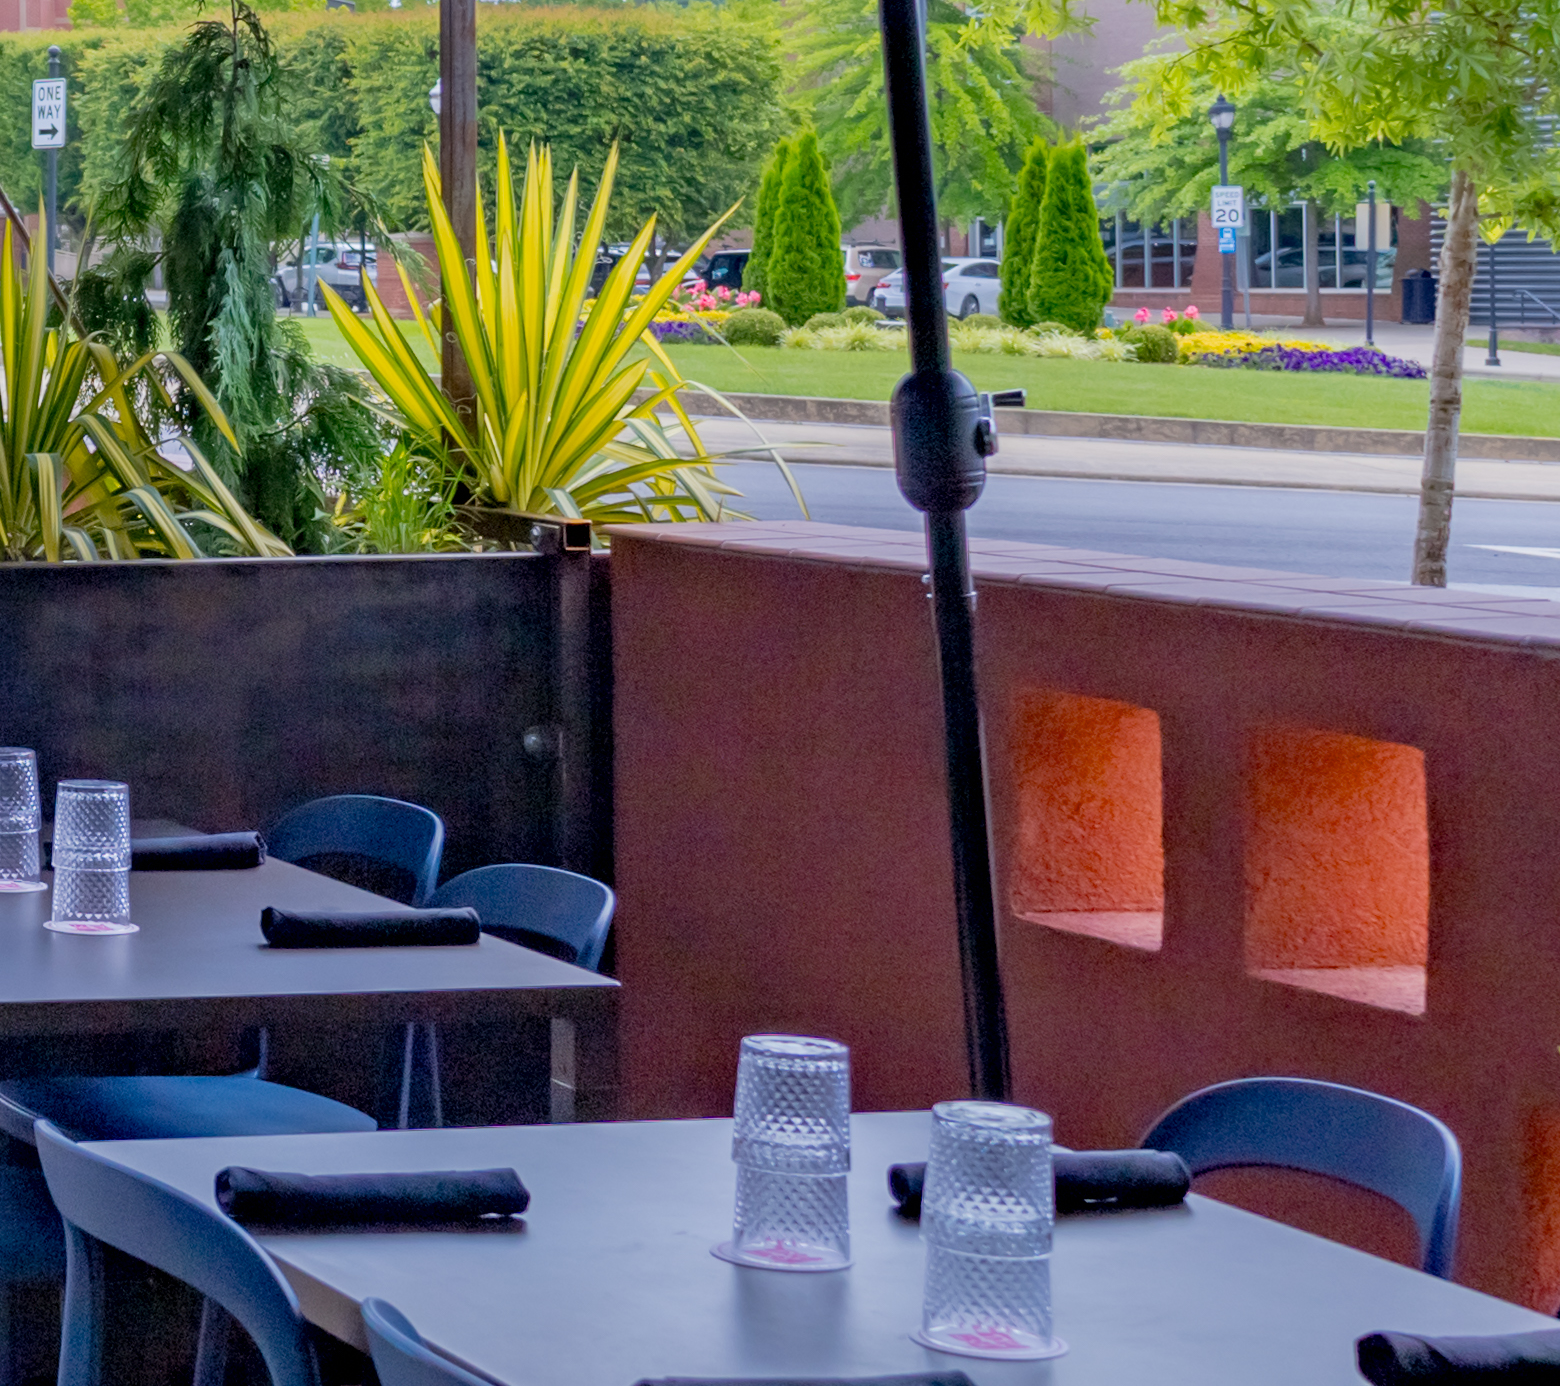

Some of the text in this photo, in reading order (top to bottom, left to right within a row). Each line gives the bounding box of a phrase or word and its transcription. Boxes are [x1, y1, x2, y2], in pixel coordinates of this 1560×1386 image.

[38, 85, 61, 102] ONE
[37, 104, 61, 120] WAY
[1217, 199, 1237, 207] LIMIT
[1215, 208, 1239, 223] 20
